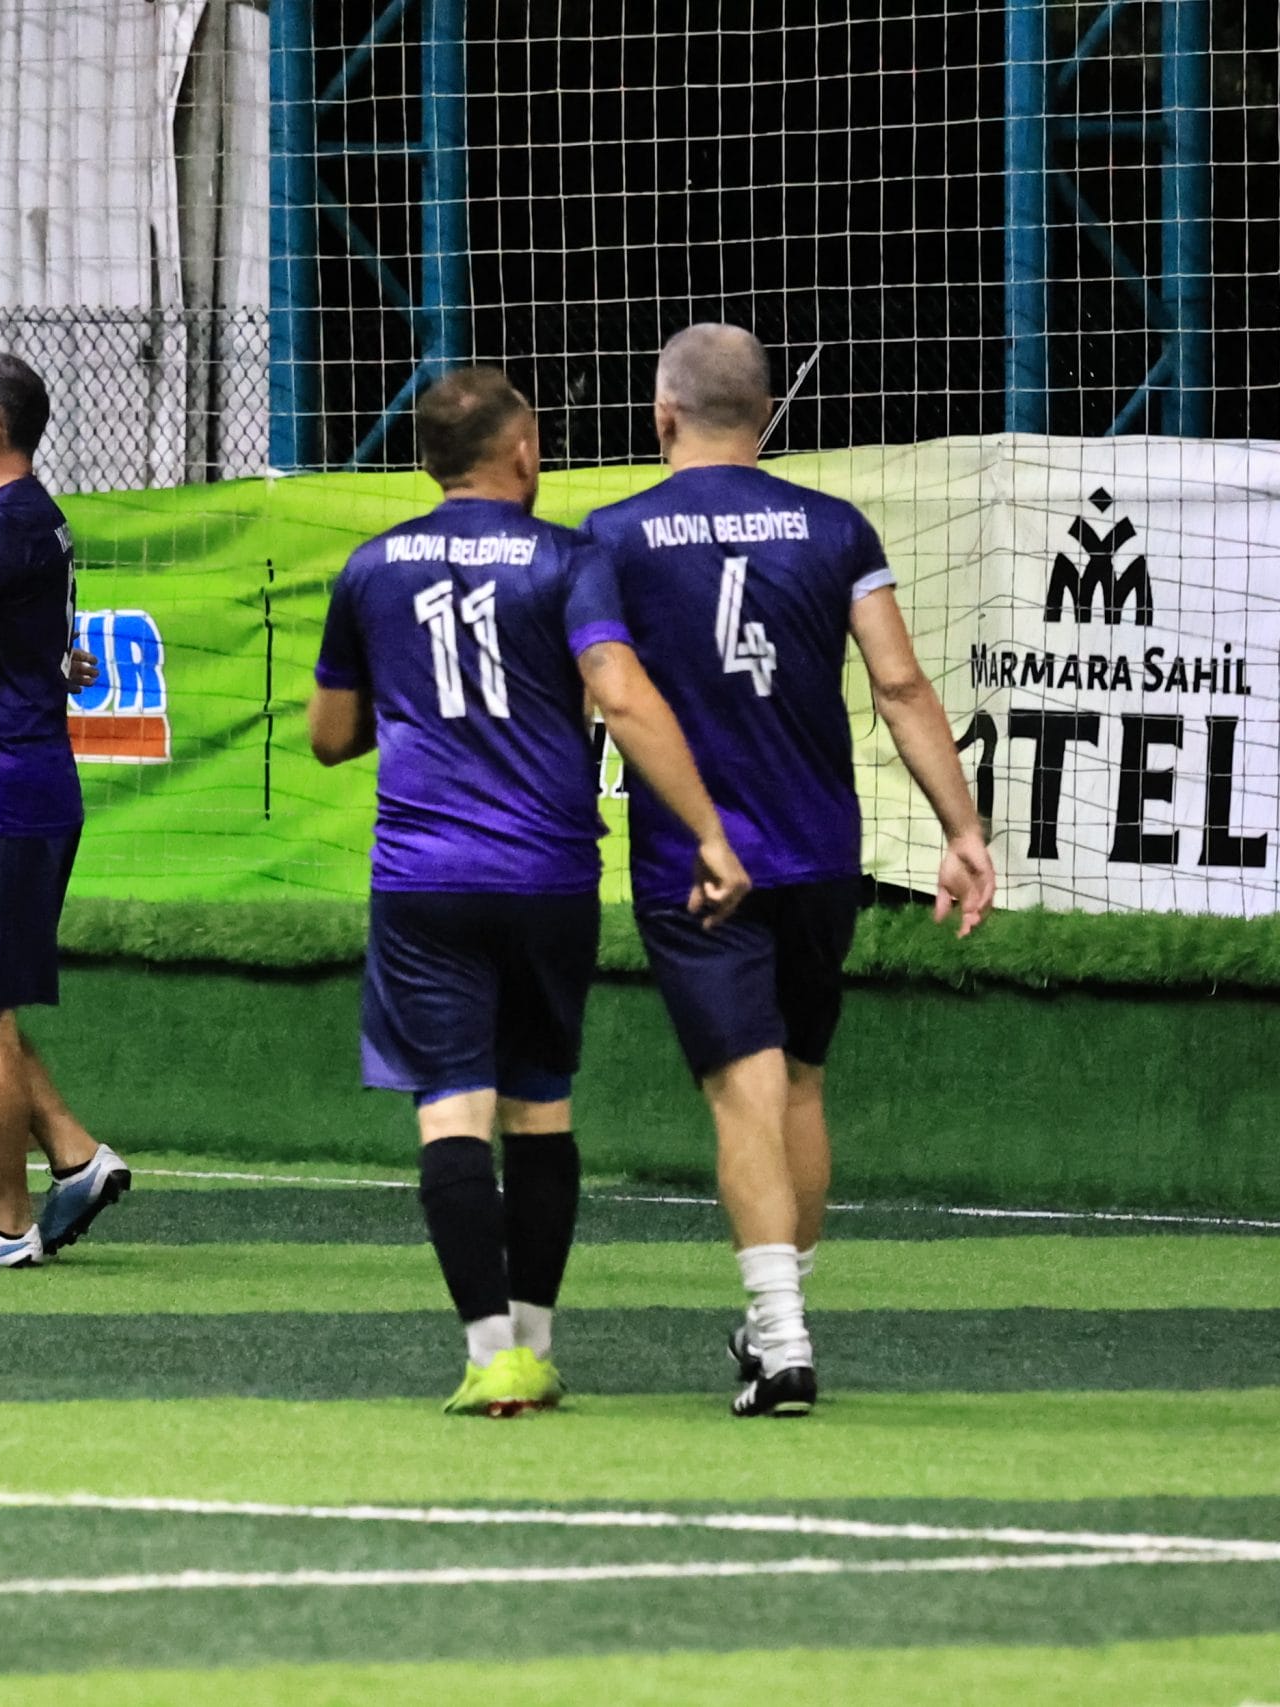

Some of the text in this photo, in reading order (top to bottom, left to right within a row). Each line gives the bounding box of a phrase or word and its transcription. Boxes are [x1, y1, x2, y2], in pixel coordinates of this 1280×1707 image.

[385, 531, 539, 566] YALOVA BELEDİYESİ
[642, 506, 810, 548] YALOVA BELEDİYESİ
[414, 580, 510, 719] 11
[715, 556, 777, 697] 4
[970, 643, 1133, 692] MARMARA
